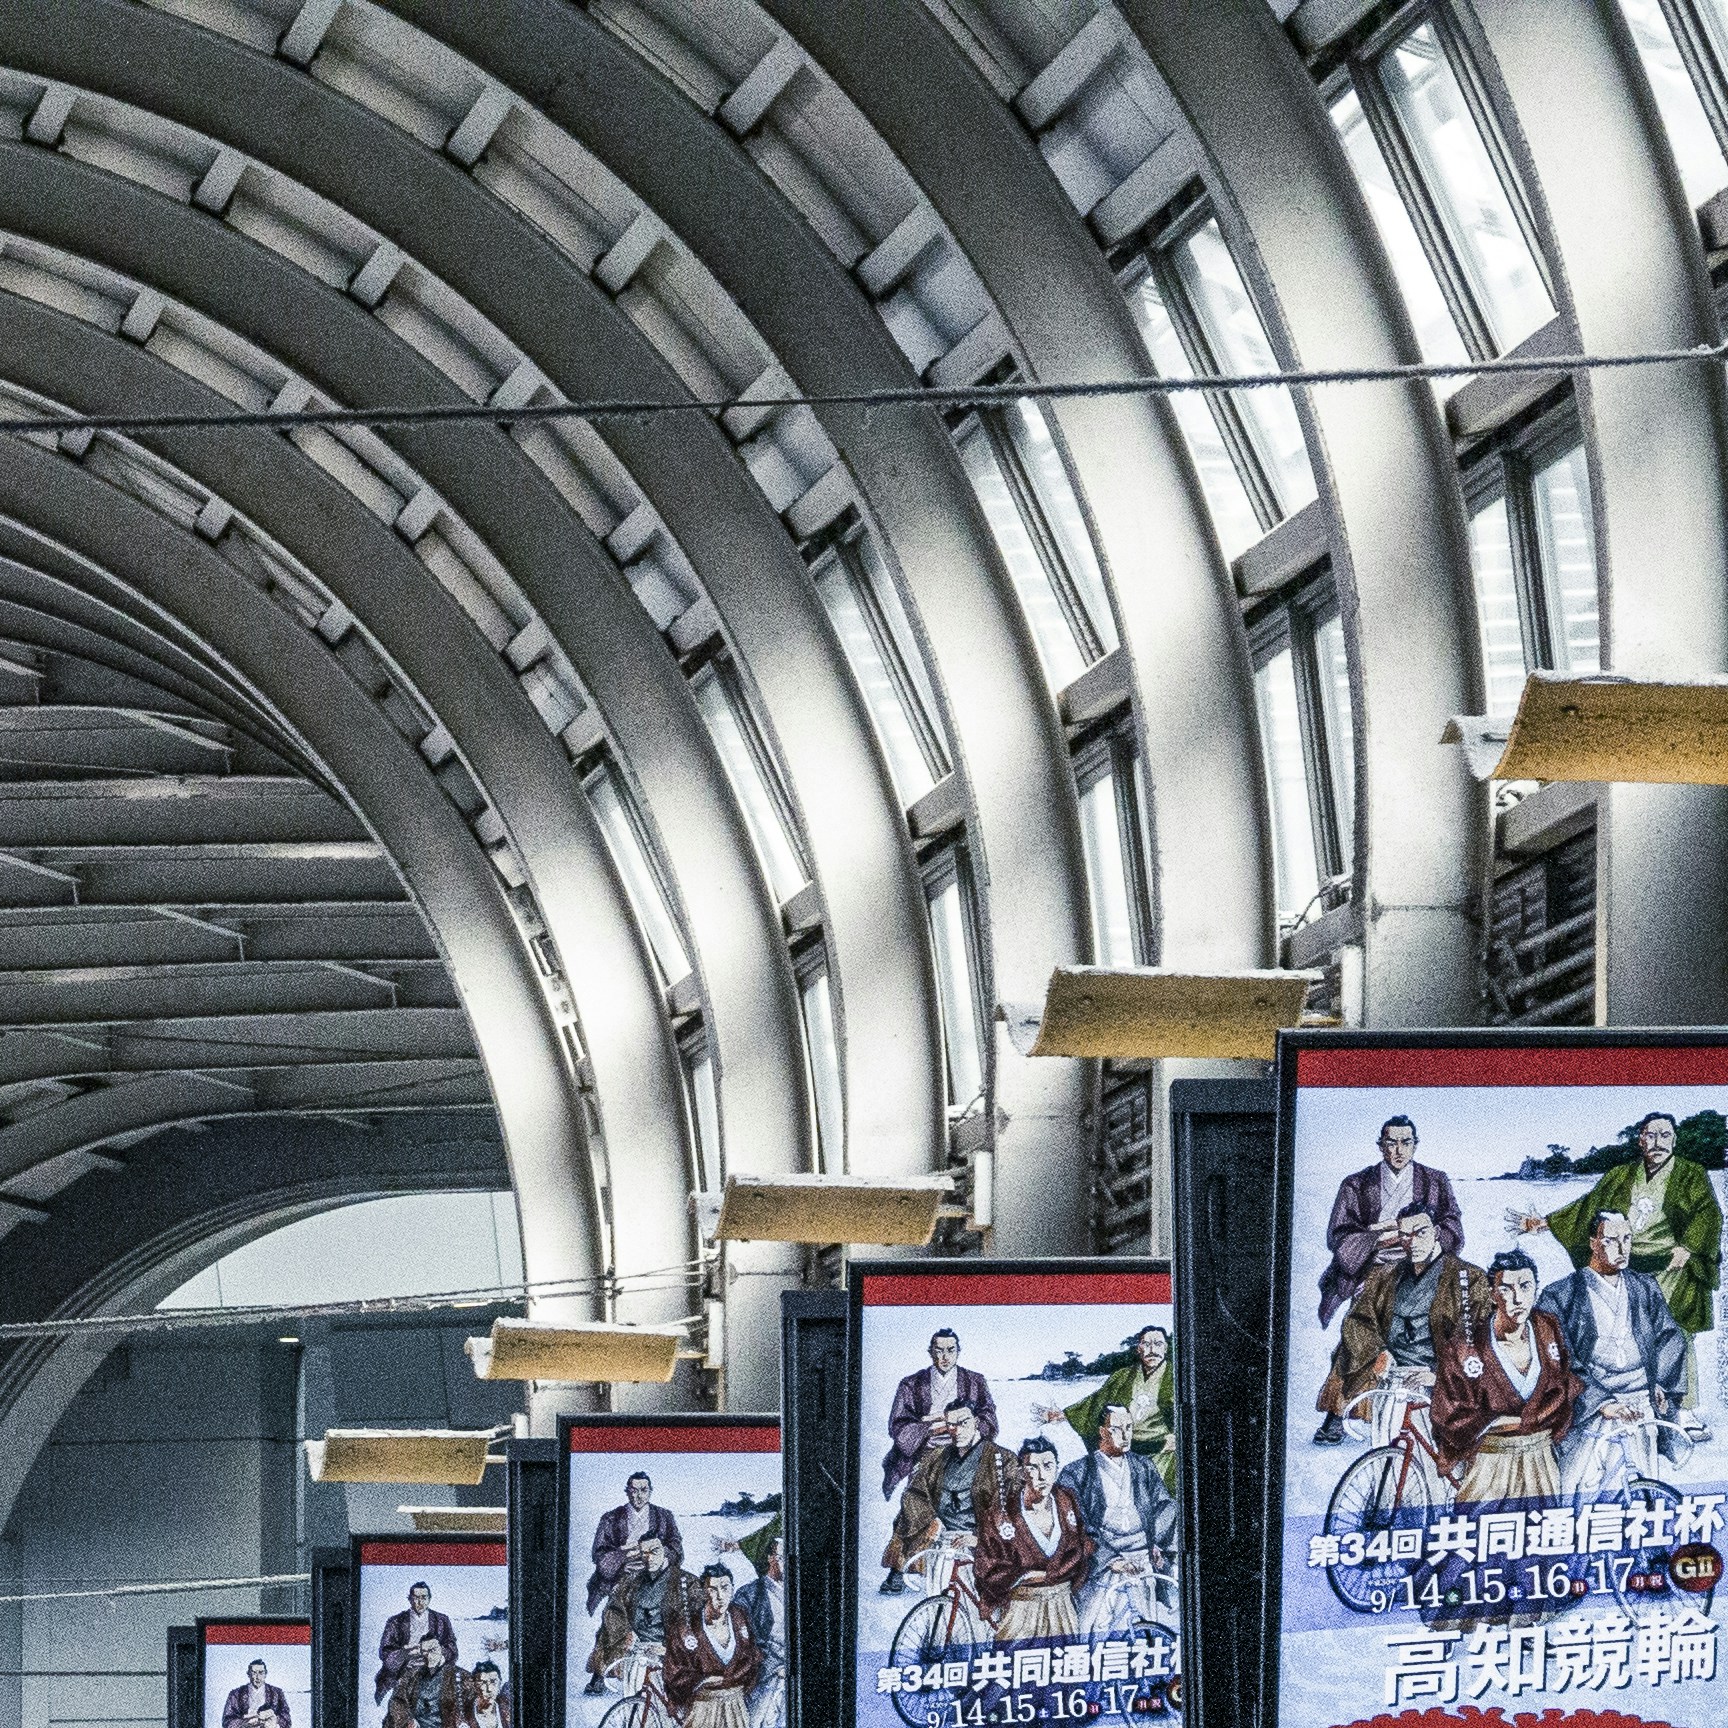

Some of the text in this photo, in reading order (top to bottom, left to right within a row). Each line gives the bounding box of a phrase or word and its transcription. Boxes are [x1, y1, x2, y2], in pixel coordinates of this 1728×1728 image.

[1308, 1493, 1726, 1568] 第34回 共同通信社杯
[1461, 1569, 1506, 1605] 15
[1526, 1563, 1571, 1598] 16
[1591, 1558, 1635, 1593] 17
[877, 1639, 1184, 1694] 第34回 共同通信社
[1387, 1608, 1719, 1707] 高知競輪
[1000, 1694, 1036, 1723] 15
[1052, 1689, 1088, 1718] 16
[1104, 1685, 1139, 1714] 17
